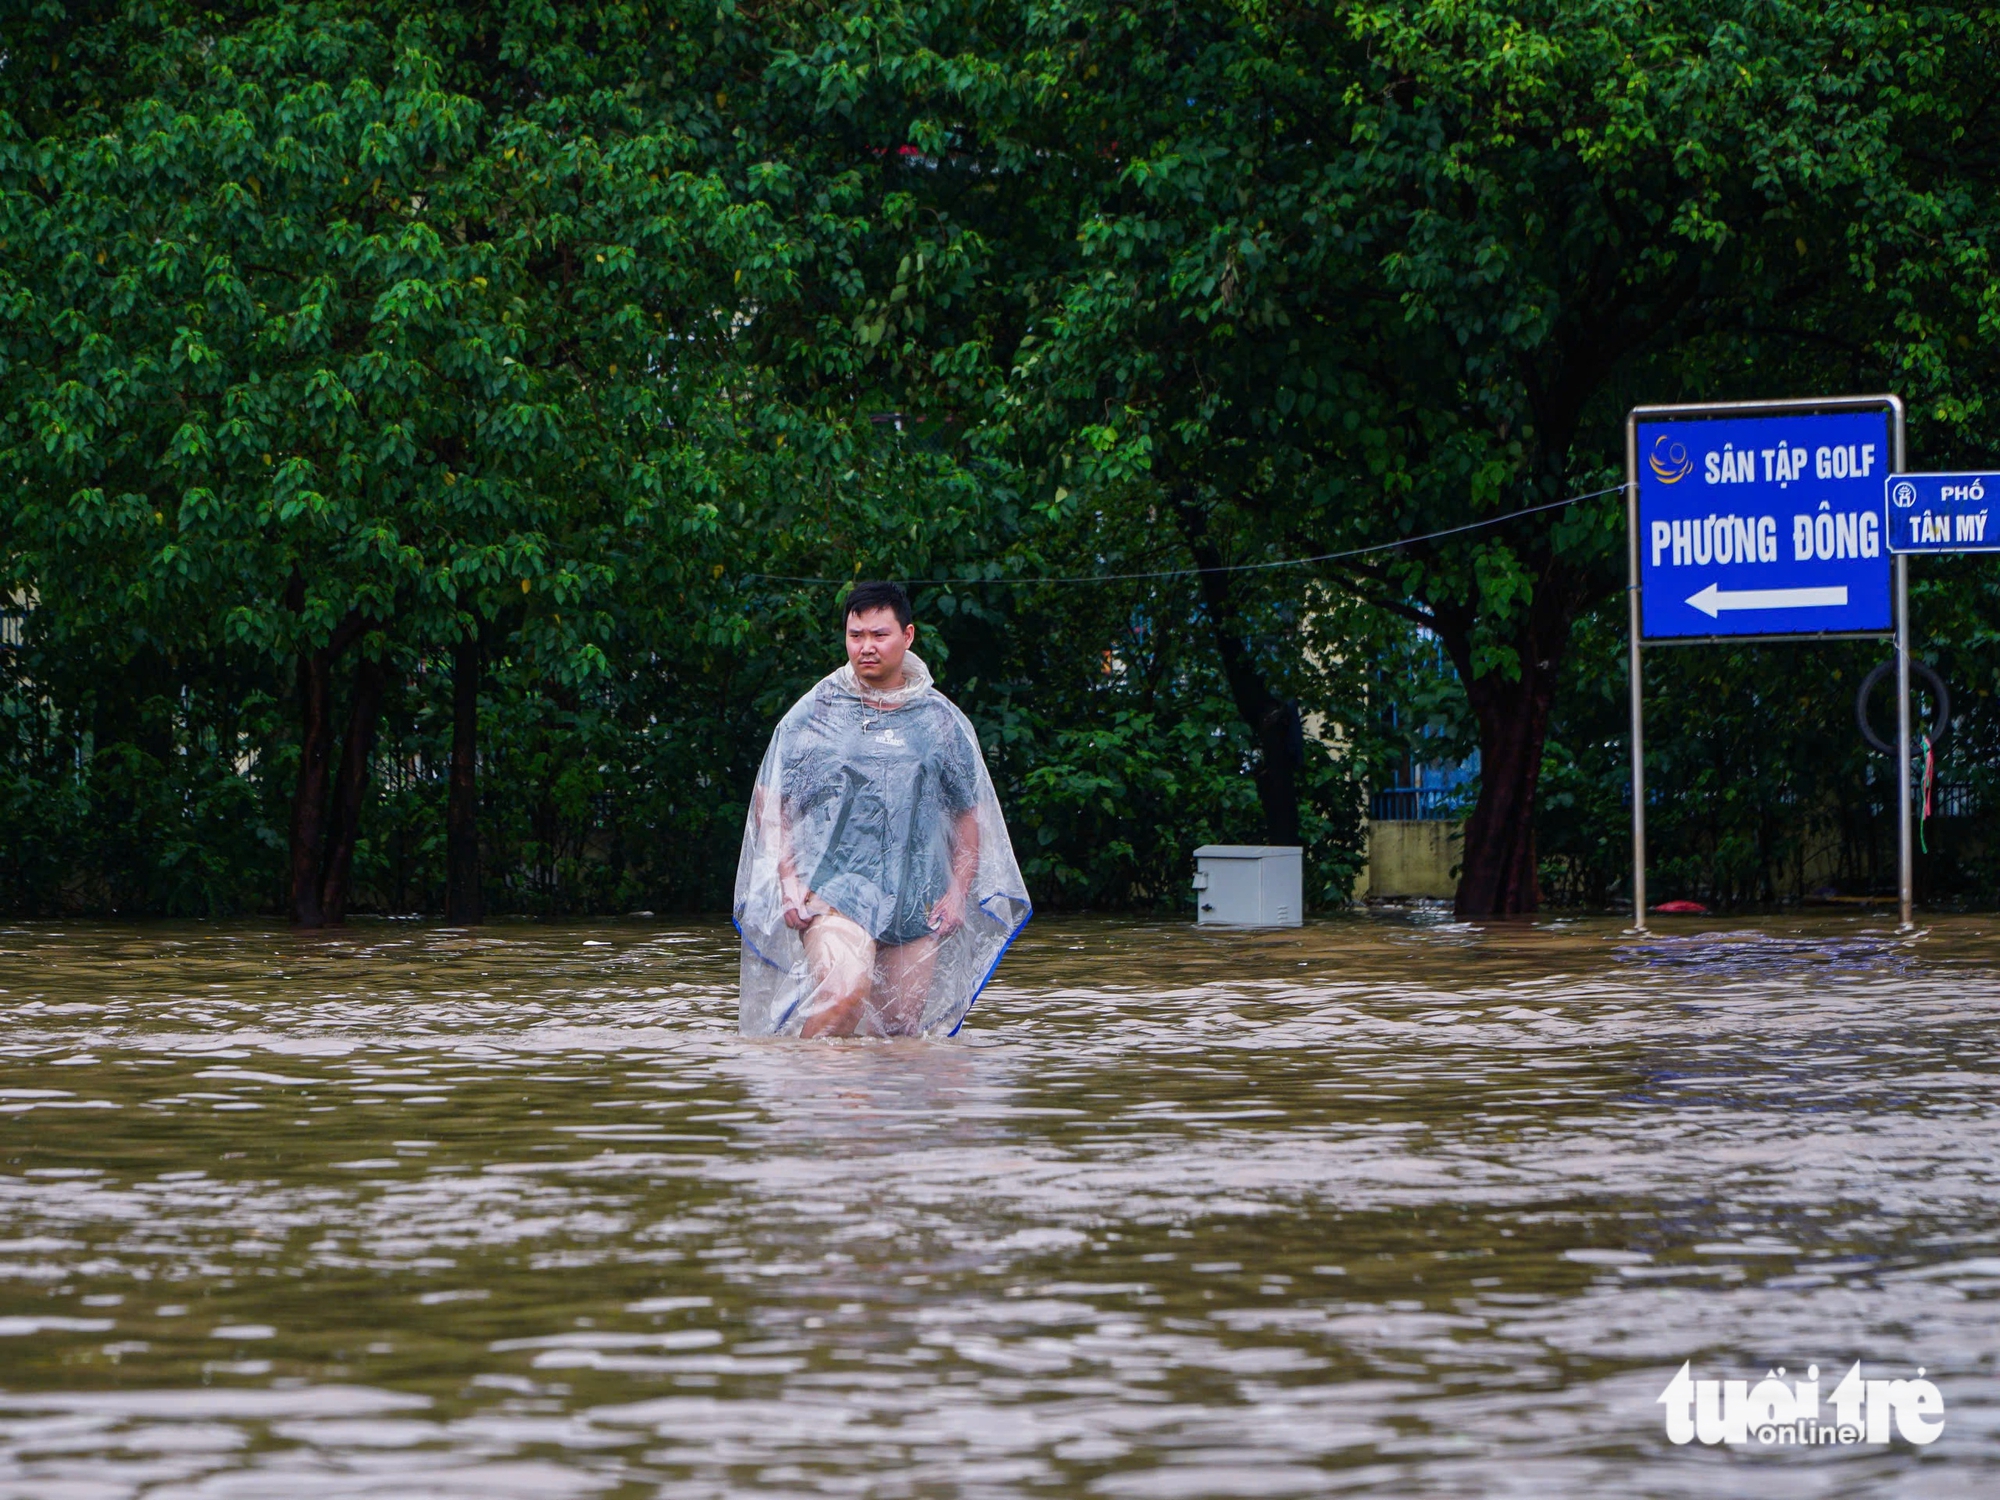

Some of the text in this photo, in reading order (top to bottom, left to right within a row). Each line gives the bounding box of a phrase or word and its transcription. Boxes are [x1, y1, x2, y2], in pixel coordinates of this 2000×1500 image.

[1705, 440, 1875, 489] SÂN TẬP GOLF
[1940, 478, 1985, 502] PHỐ
[1651, 500, 1879, 567] PHƯƠNG ĐÔNG
[1909, 508, 1989, 543] TÂN MỸ
